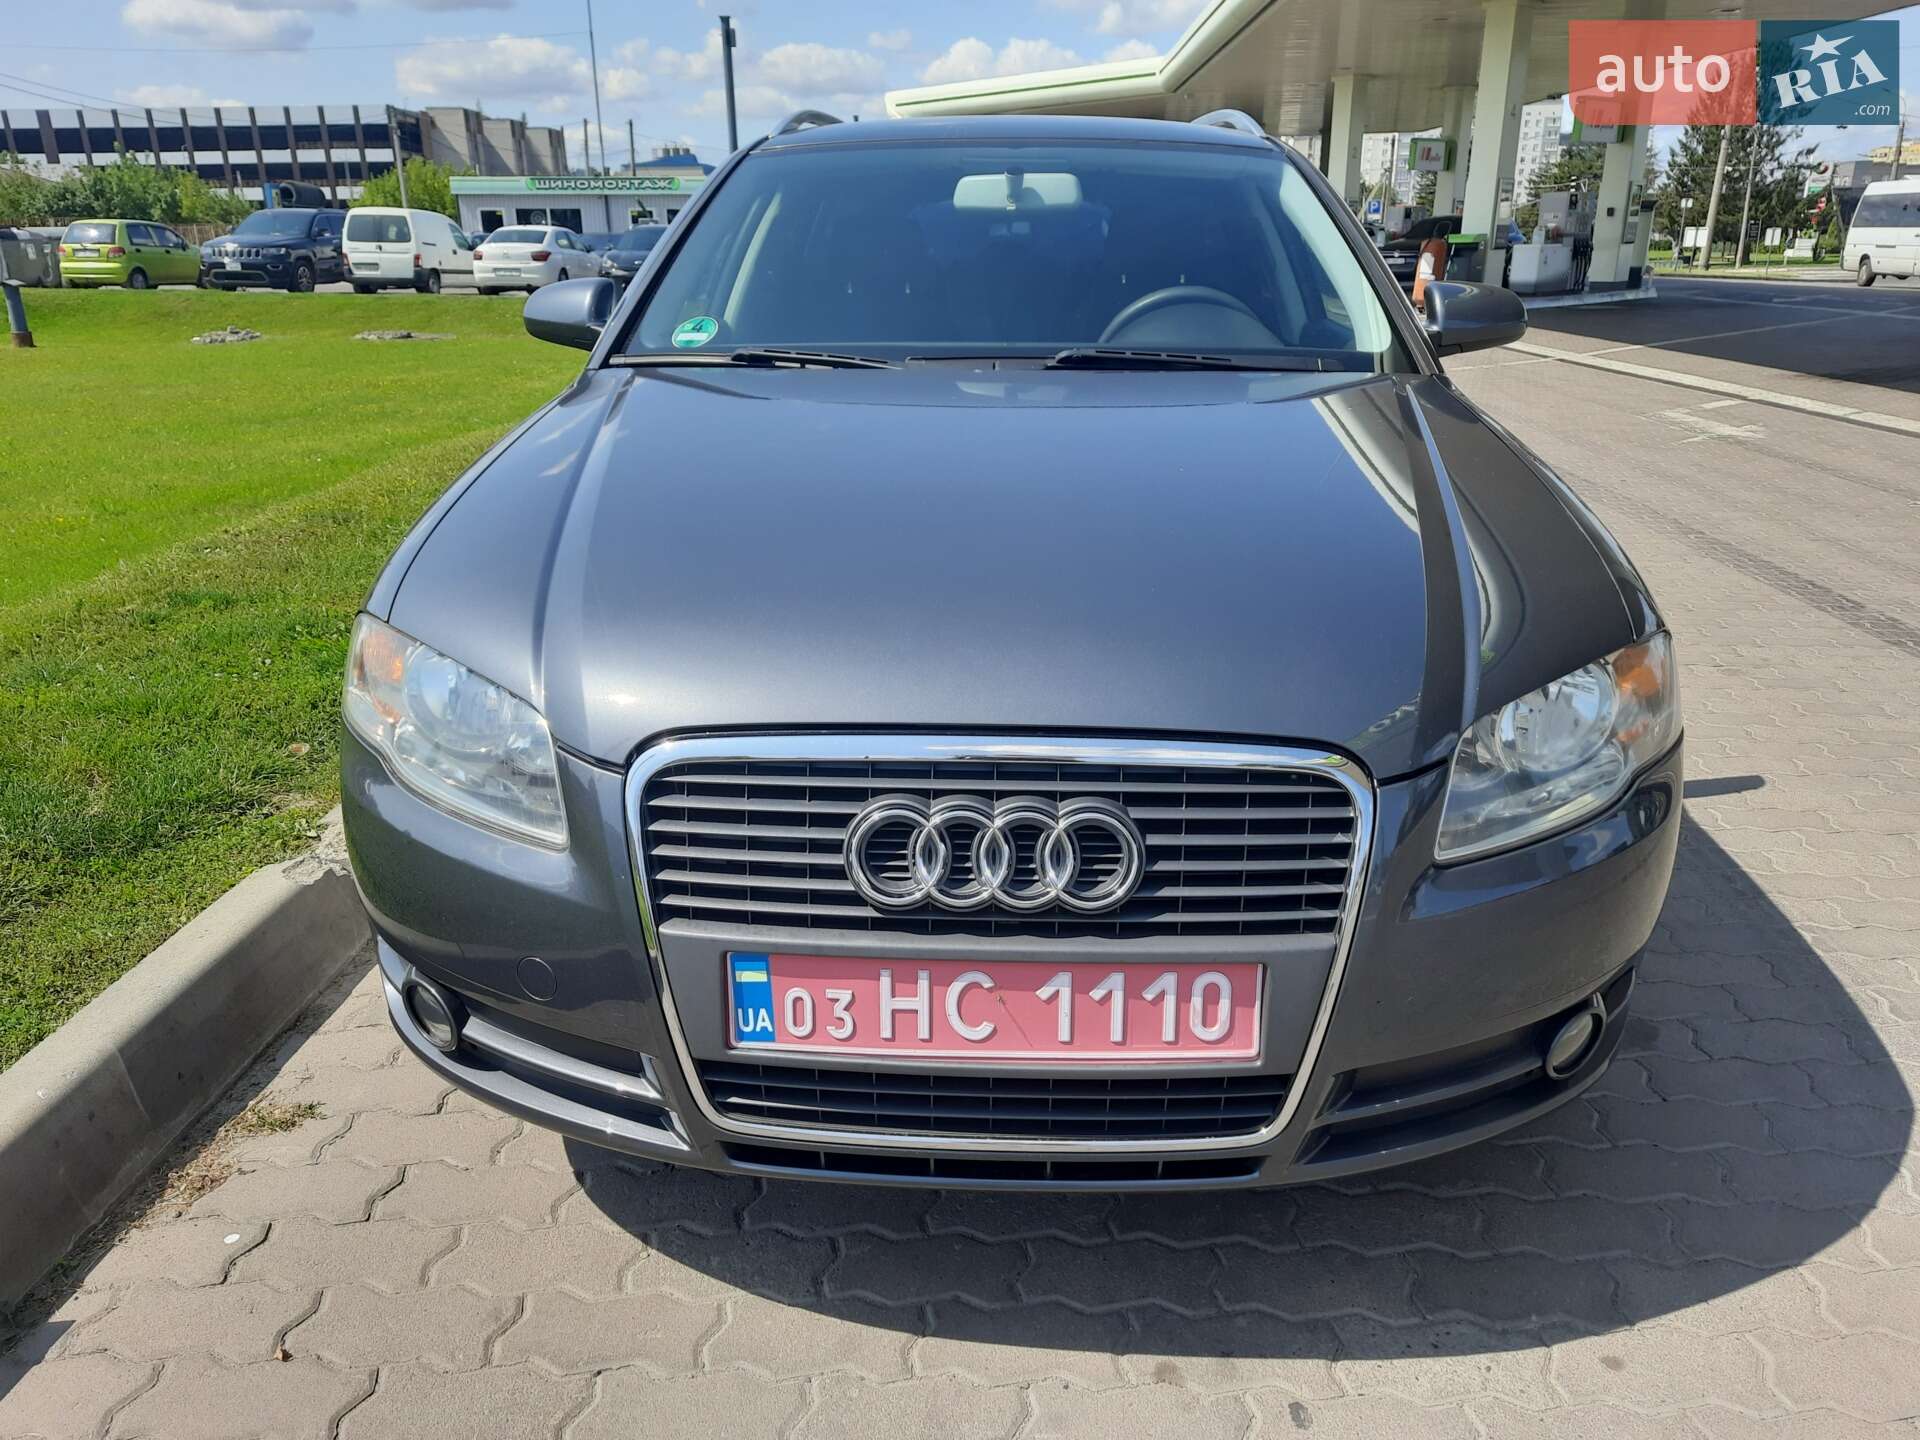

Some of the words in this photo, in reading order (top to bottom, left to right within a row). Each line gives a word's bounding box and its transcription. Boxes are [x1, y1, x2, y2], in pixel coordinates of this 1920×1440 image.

[535, 178, 673, 191] ШИНОМОНТАЖ
[691, 319, 705, 333] 4
[784, 988, 856, 1040] 03
[879, 968, 998, 1042] HC
[1035, 970, 1233, 1043] 1110
[737, 1008, 773, 1032] UA
